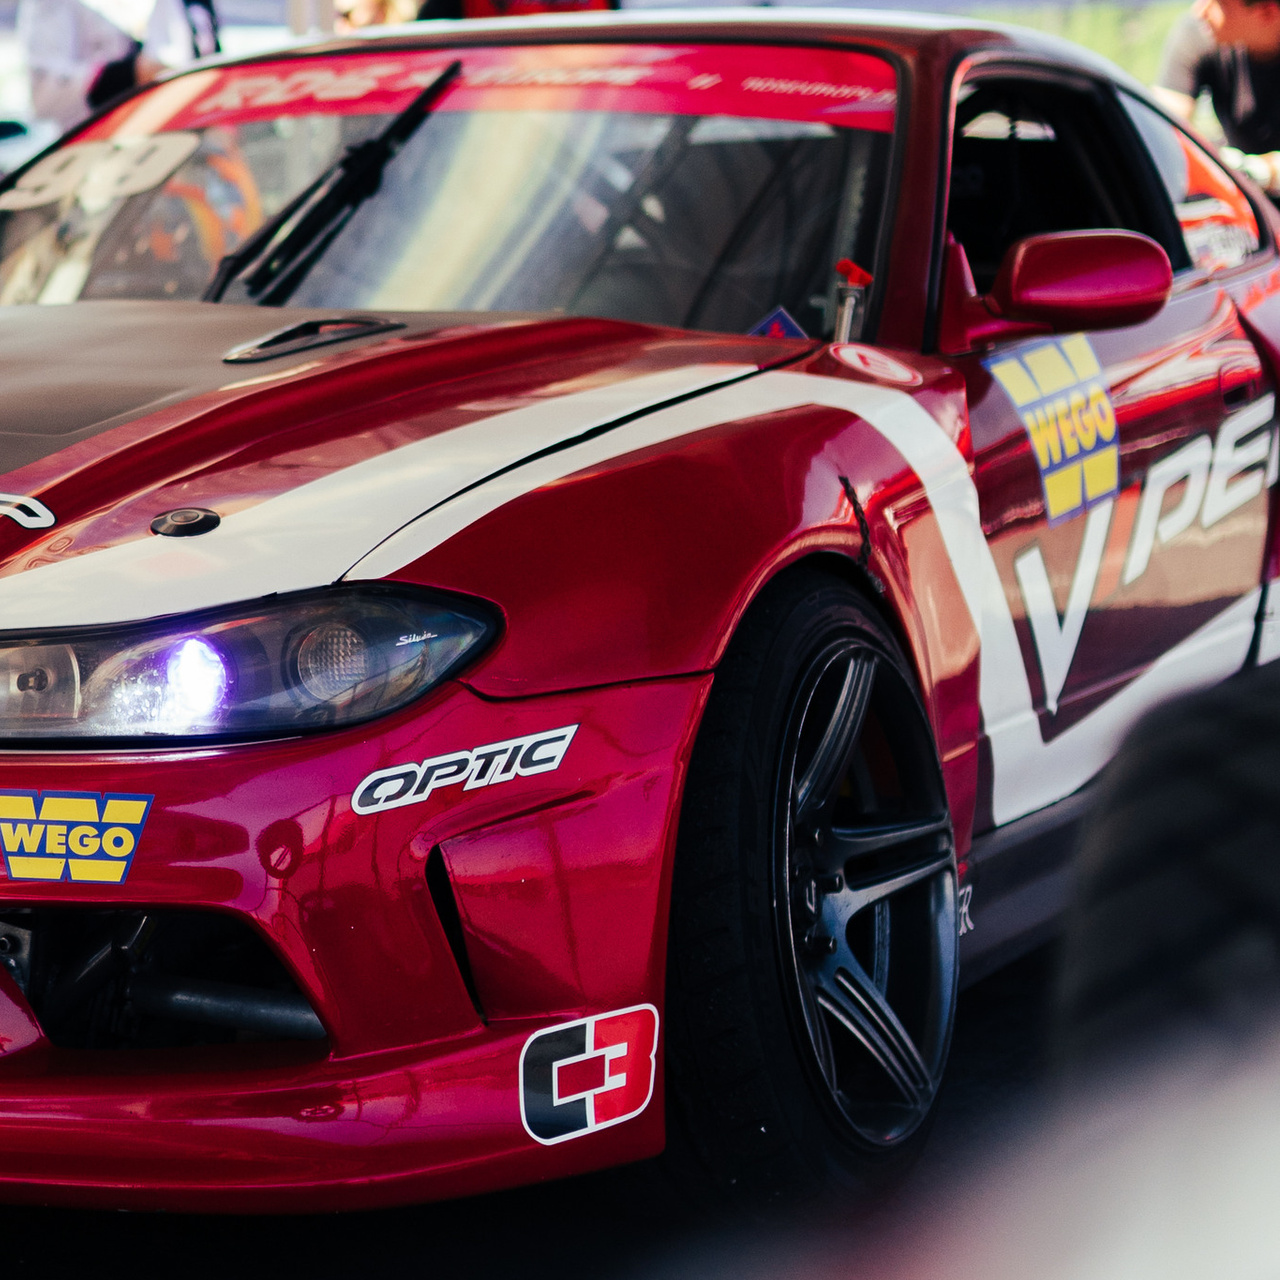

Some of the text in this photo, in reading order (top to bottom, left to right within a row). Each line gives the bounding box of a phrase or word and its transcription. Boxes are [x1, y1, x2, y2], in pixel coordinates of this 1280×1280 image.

[1023, 380, 1117, 472] WEGO
[352, 724, 578, 815] OPTIC
[0, 822, 135, 858] WEGO
[520, 1003, 660, 1146] C3
